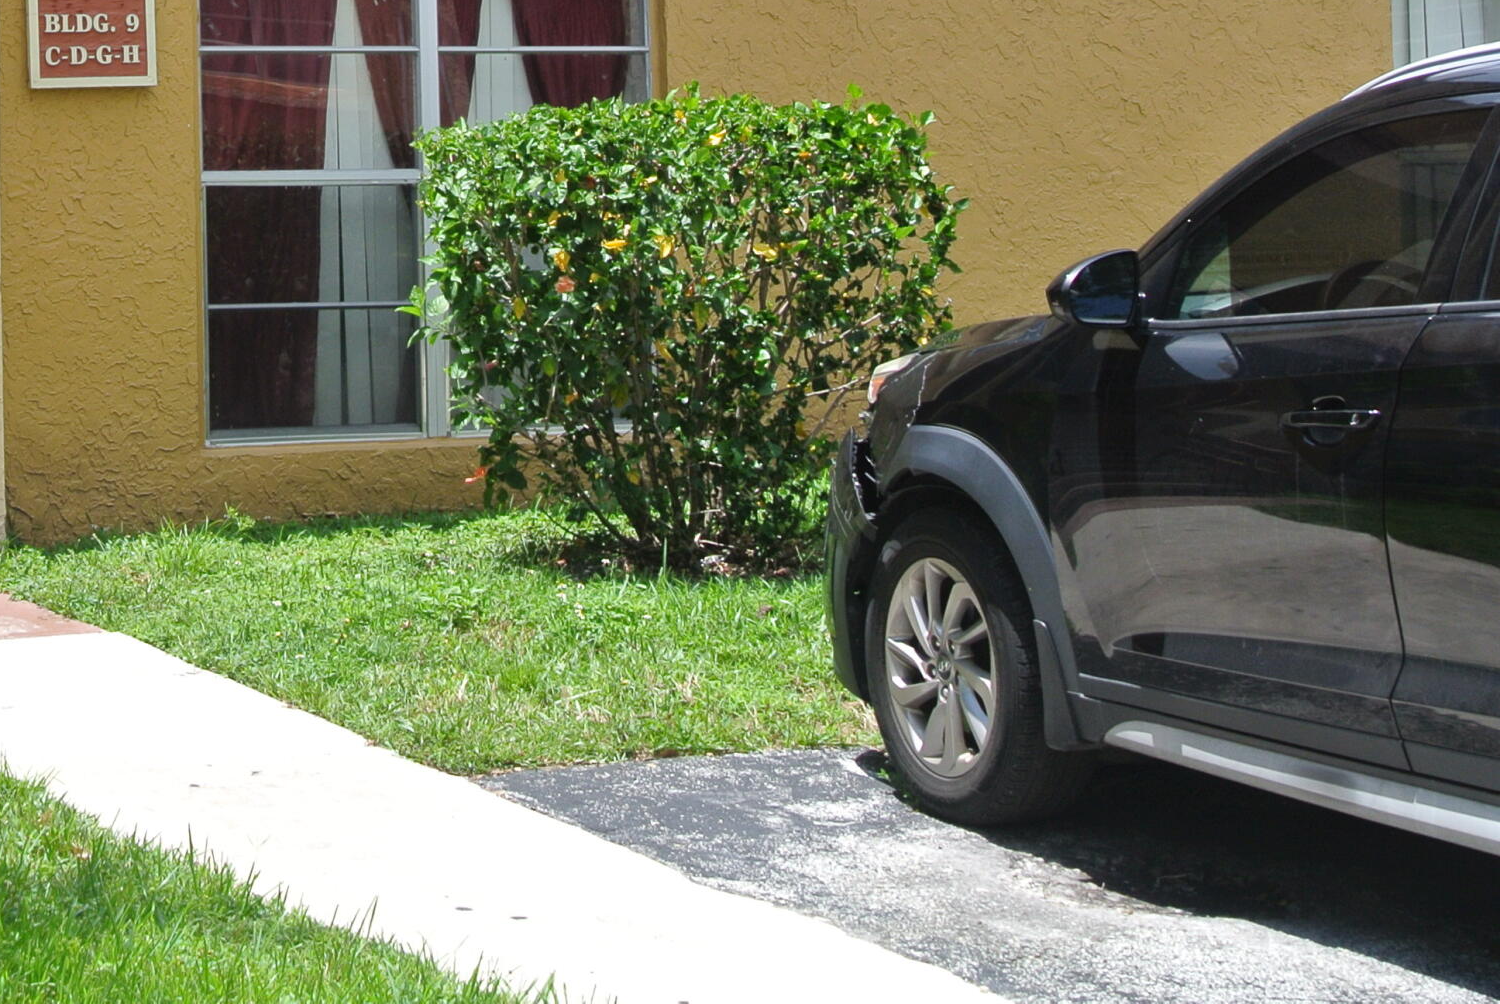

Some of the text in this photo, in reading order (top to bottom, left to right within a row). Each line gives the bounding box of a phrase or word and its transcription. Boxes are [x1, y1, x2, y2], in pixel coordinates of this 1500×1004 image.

[44, 13, 140, 34] BLDG. 9
[45, 44, 141, 66] C-D-G-H
